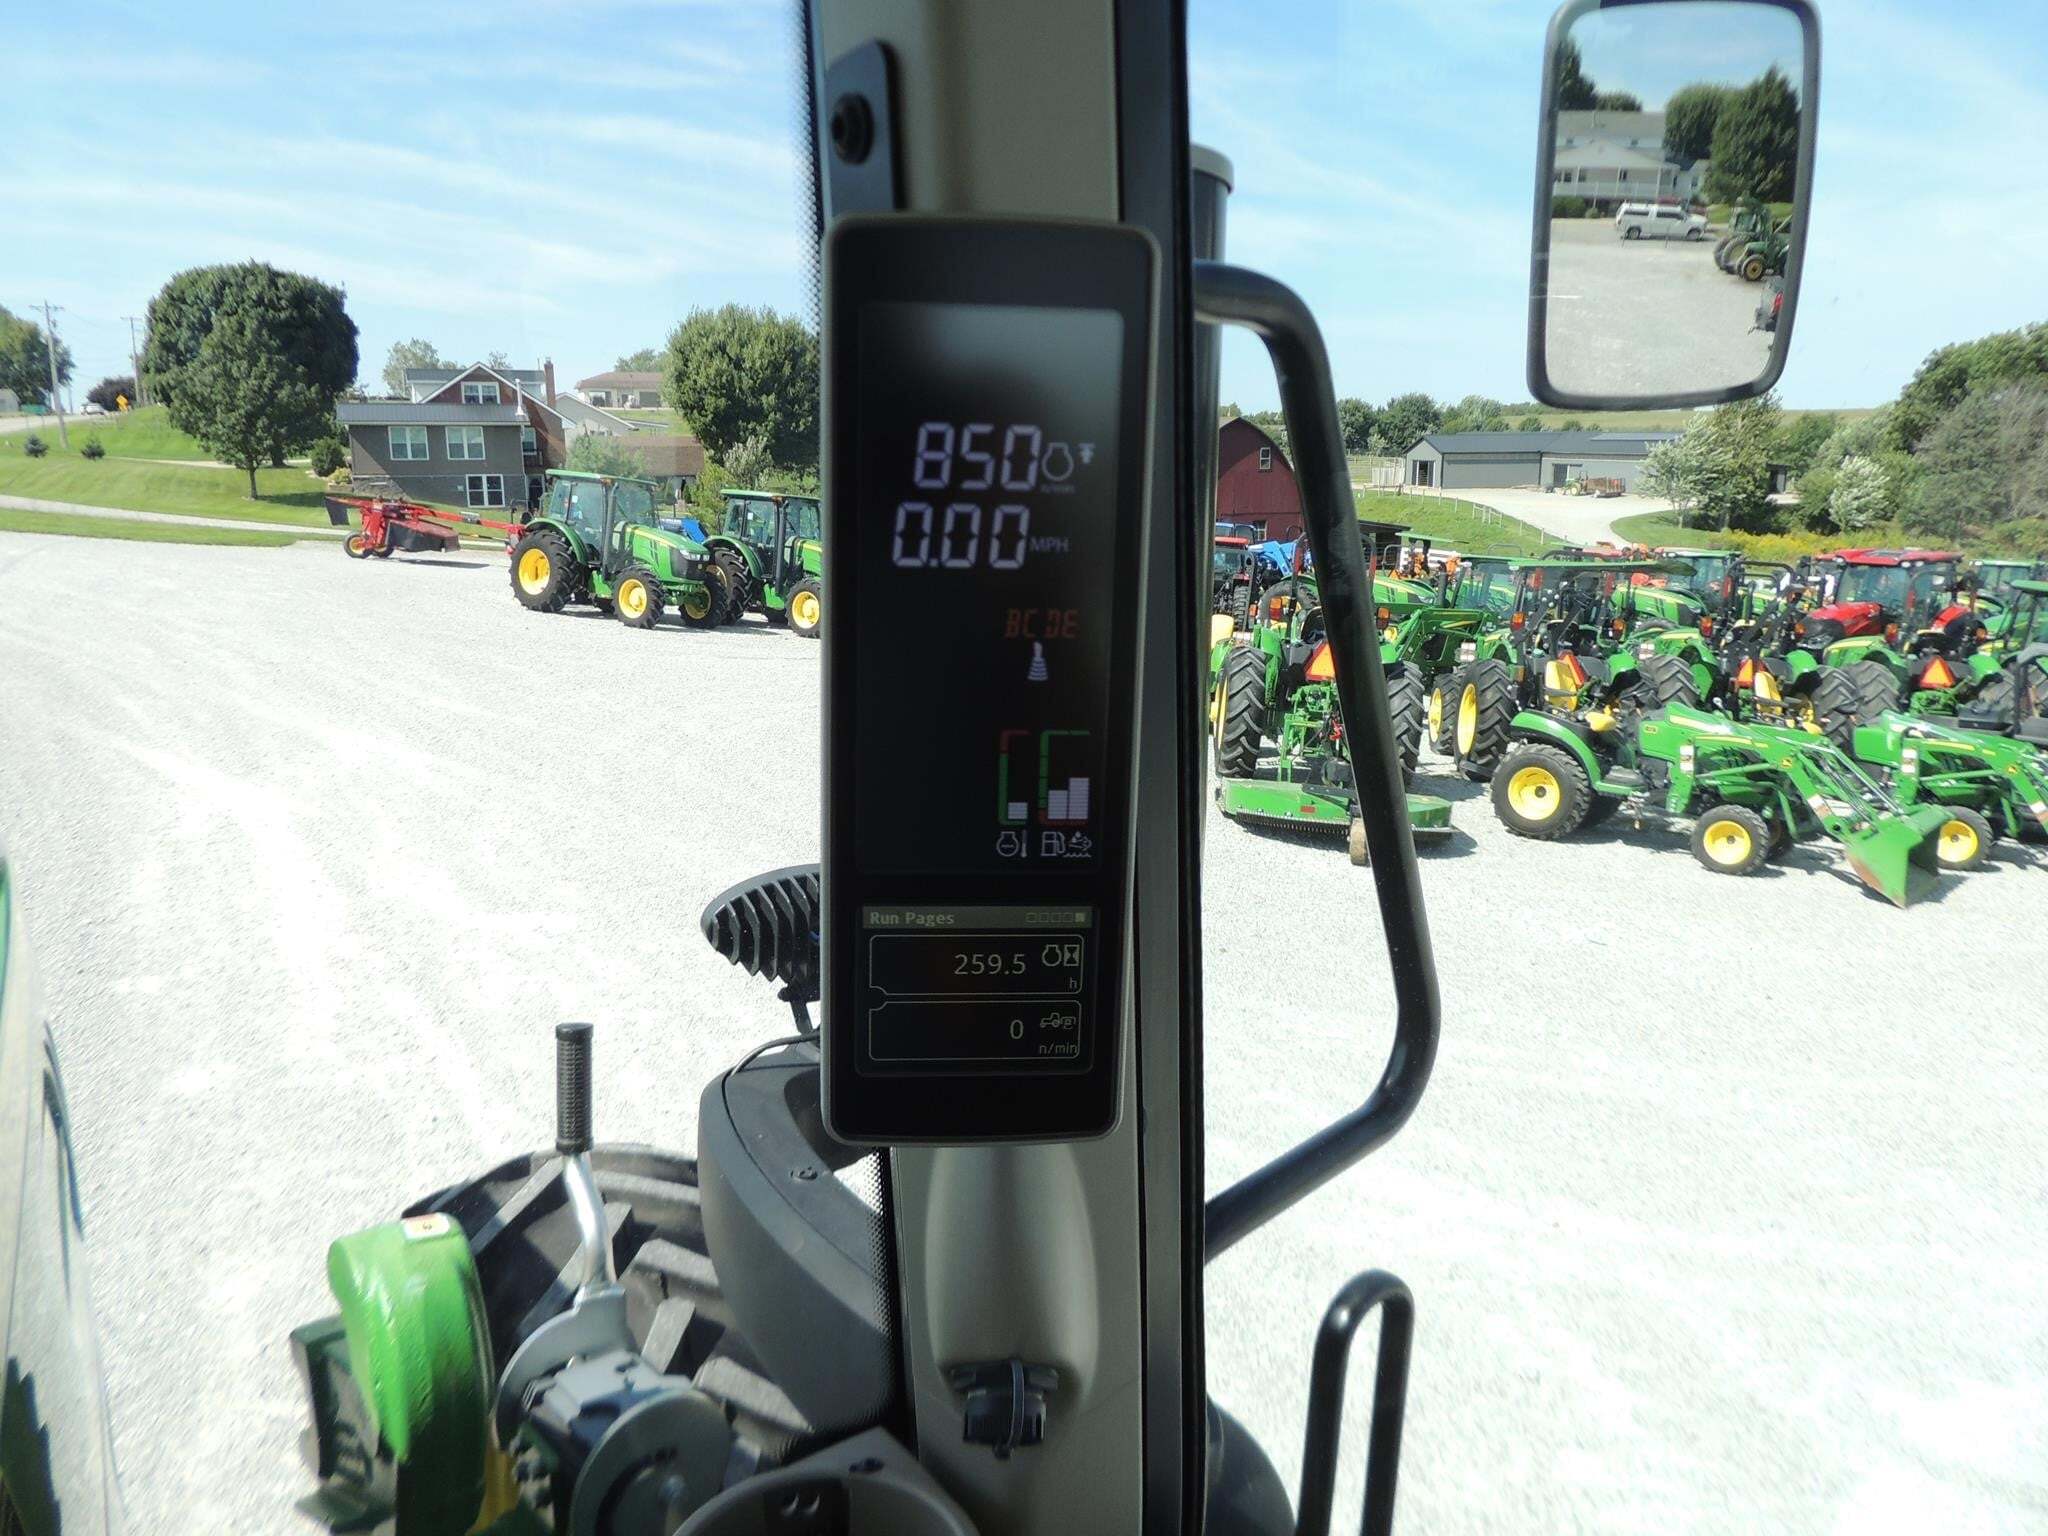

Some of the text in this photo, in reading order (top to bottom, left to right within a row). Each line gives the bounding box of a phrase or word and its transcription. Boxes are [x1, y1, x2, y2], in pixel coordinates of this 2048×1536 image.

[914, 422, 1042, 491] 850
[892, 501, 1069, 569] 0.00 MPH
[870, 911, 955, 927] Run Pages
[953, 953, 1027, 976] 259.5
[1009, 1018, 1024, 1040] 0
[1039, 1042, 1079, 1056] n/min
